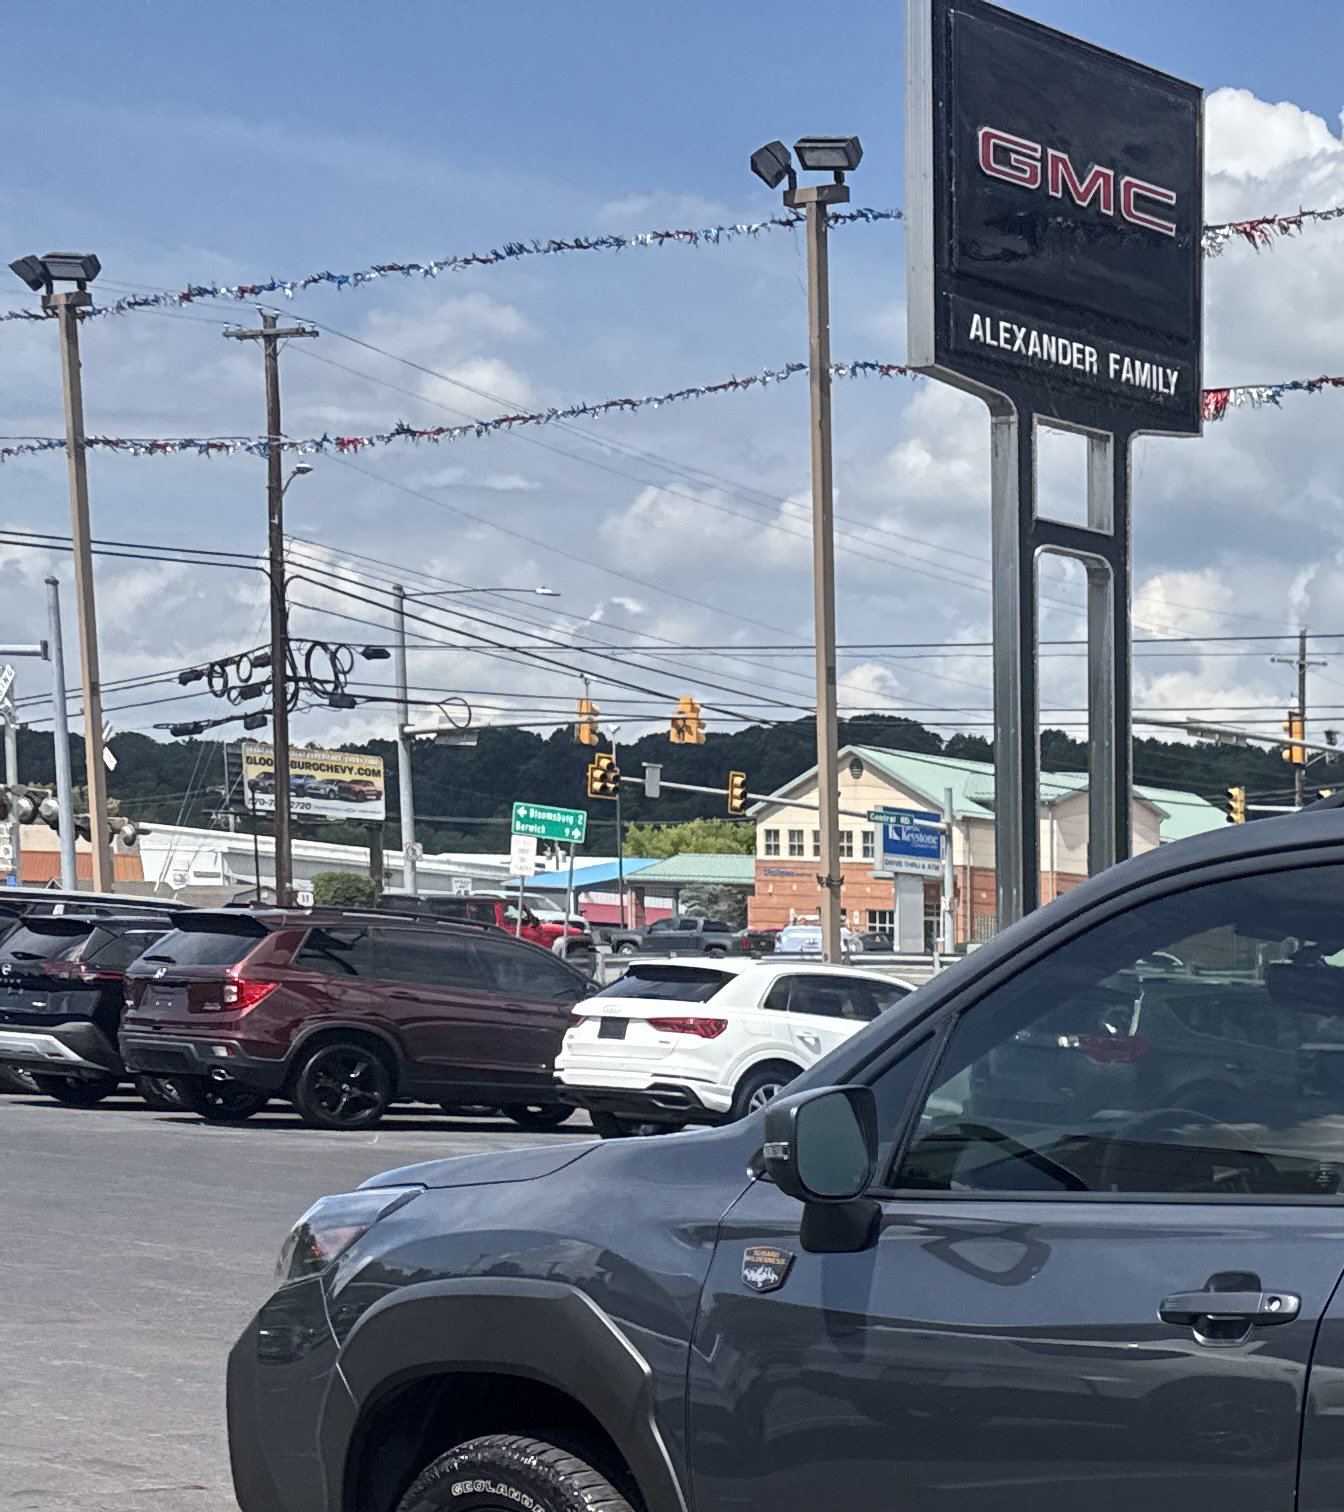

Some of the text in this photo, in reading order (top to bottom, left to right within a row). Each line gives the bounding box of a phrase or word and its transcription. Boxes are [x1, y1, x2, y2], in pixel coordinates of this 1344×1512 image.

[978, 126, 1176, 236] GMC
[969, 313, 1179, 396] ALEXANDER FAMILY
[529, 807, 574, 825] Bloomsburg
[869, 812, 897, 823] Central
[515, 820, 546, 834] Berwick
